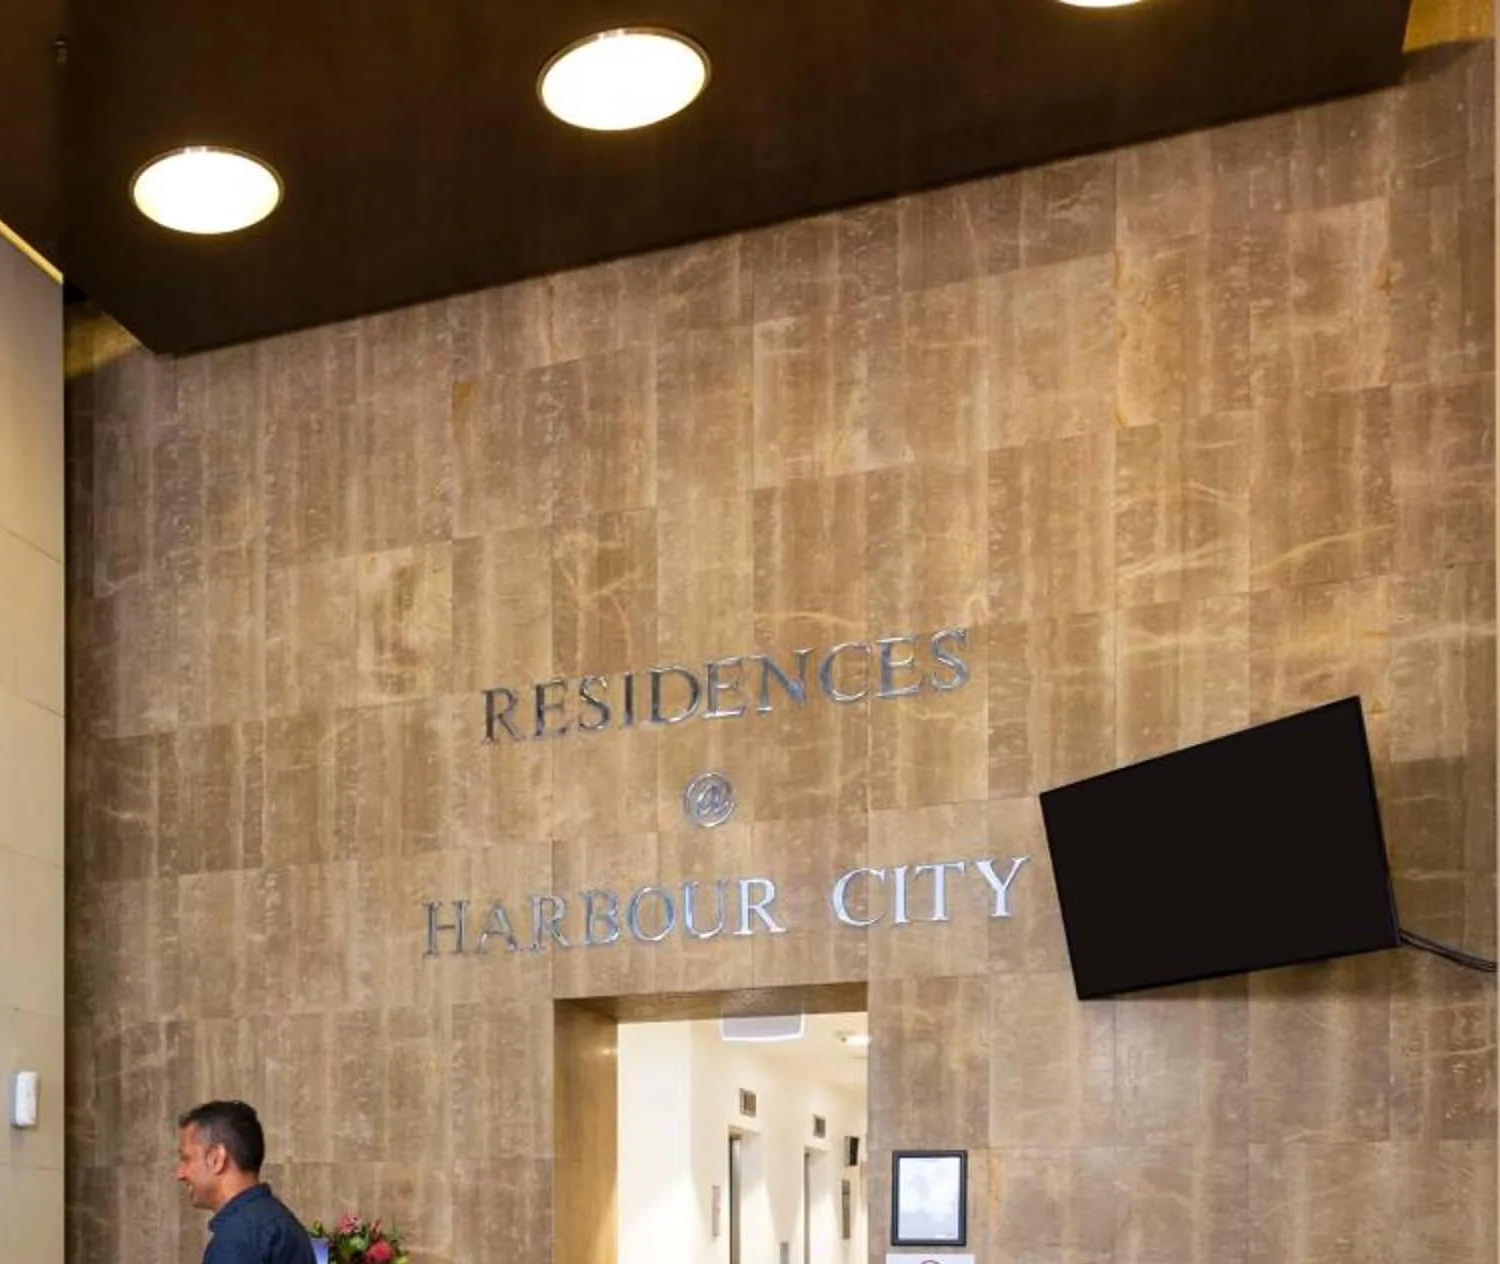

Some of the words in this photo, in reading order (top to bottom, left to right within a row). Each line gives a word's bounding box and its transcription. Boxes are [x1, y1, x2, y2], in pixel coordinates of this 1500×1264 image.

[480, 626, 970, 745] RESIDENCES
[684, 772, 737, 828] @
[422, 876, 787, 958] HARBOUR
[831, 855, 1030, 928] CITY
